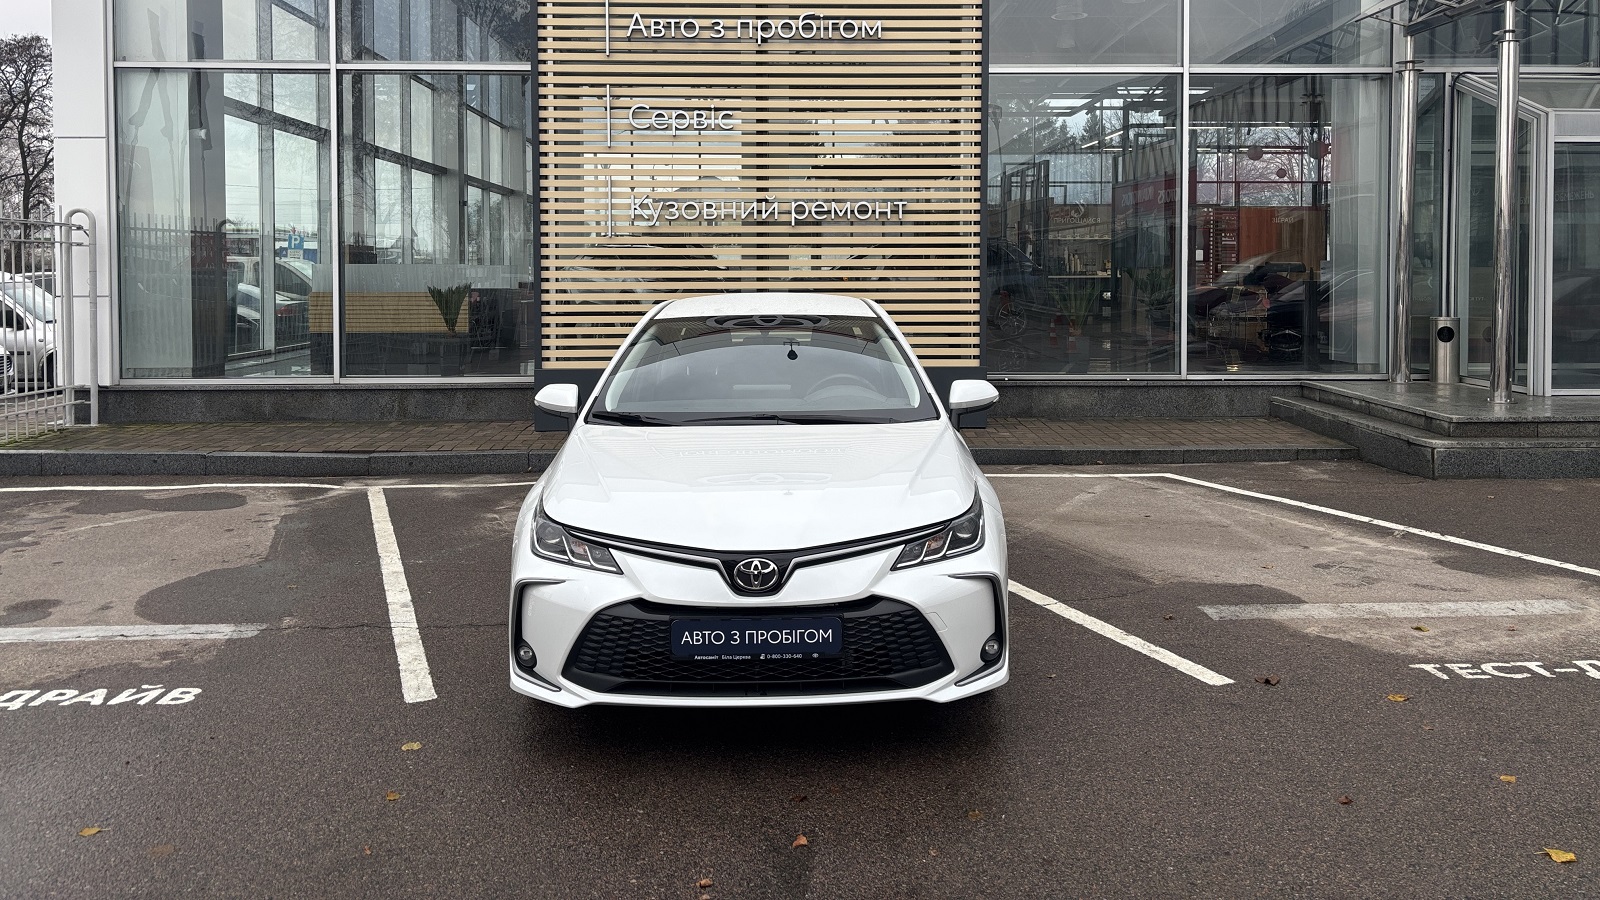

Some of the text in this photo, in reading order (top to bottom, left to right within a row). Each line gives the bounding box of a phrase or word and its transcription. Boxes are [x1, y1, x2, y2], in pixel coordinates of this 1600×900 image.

[626, 12, 882, 46] Авто з пробігом
[629, 104, 734, 136] Сервіс
[630, 194, 907, 226] Кузовний ремонт
[681, 629, 833, 645] АВТО З ПРОБІГОМ
